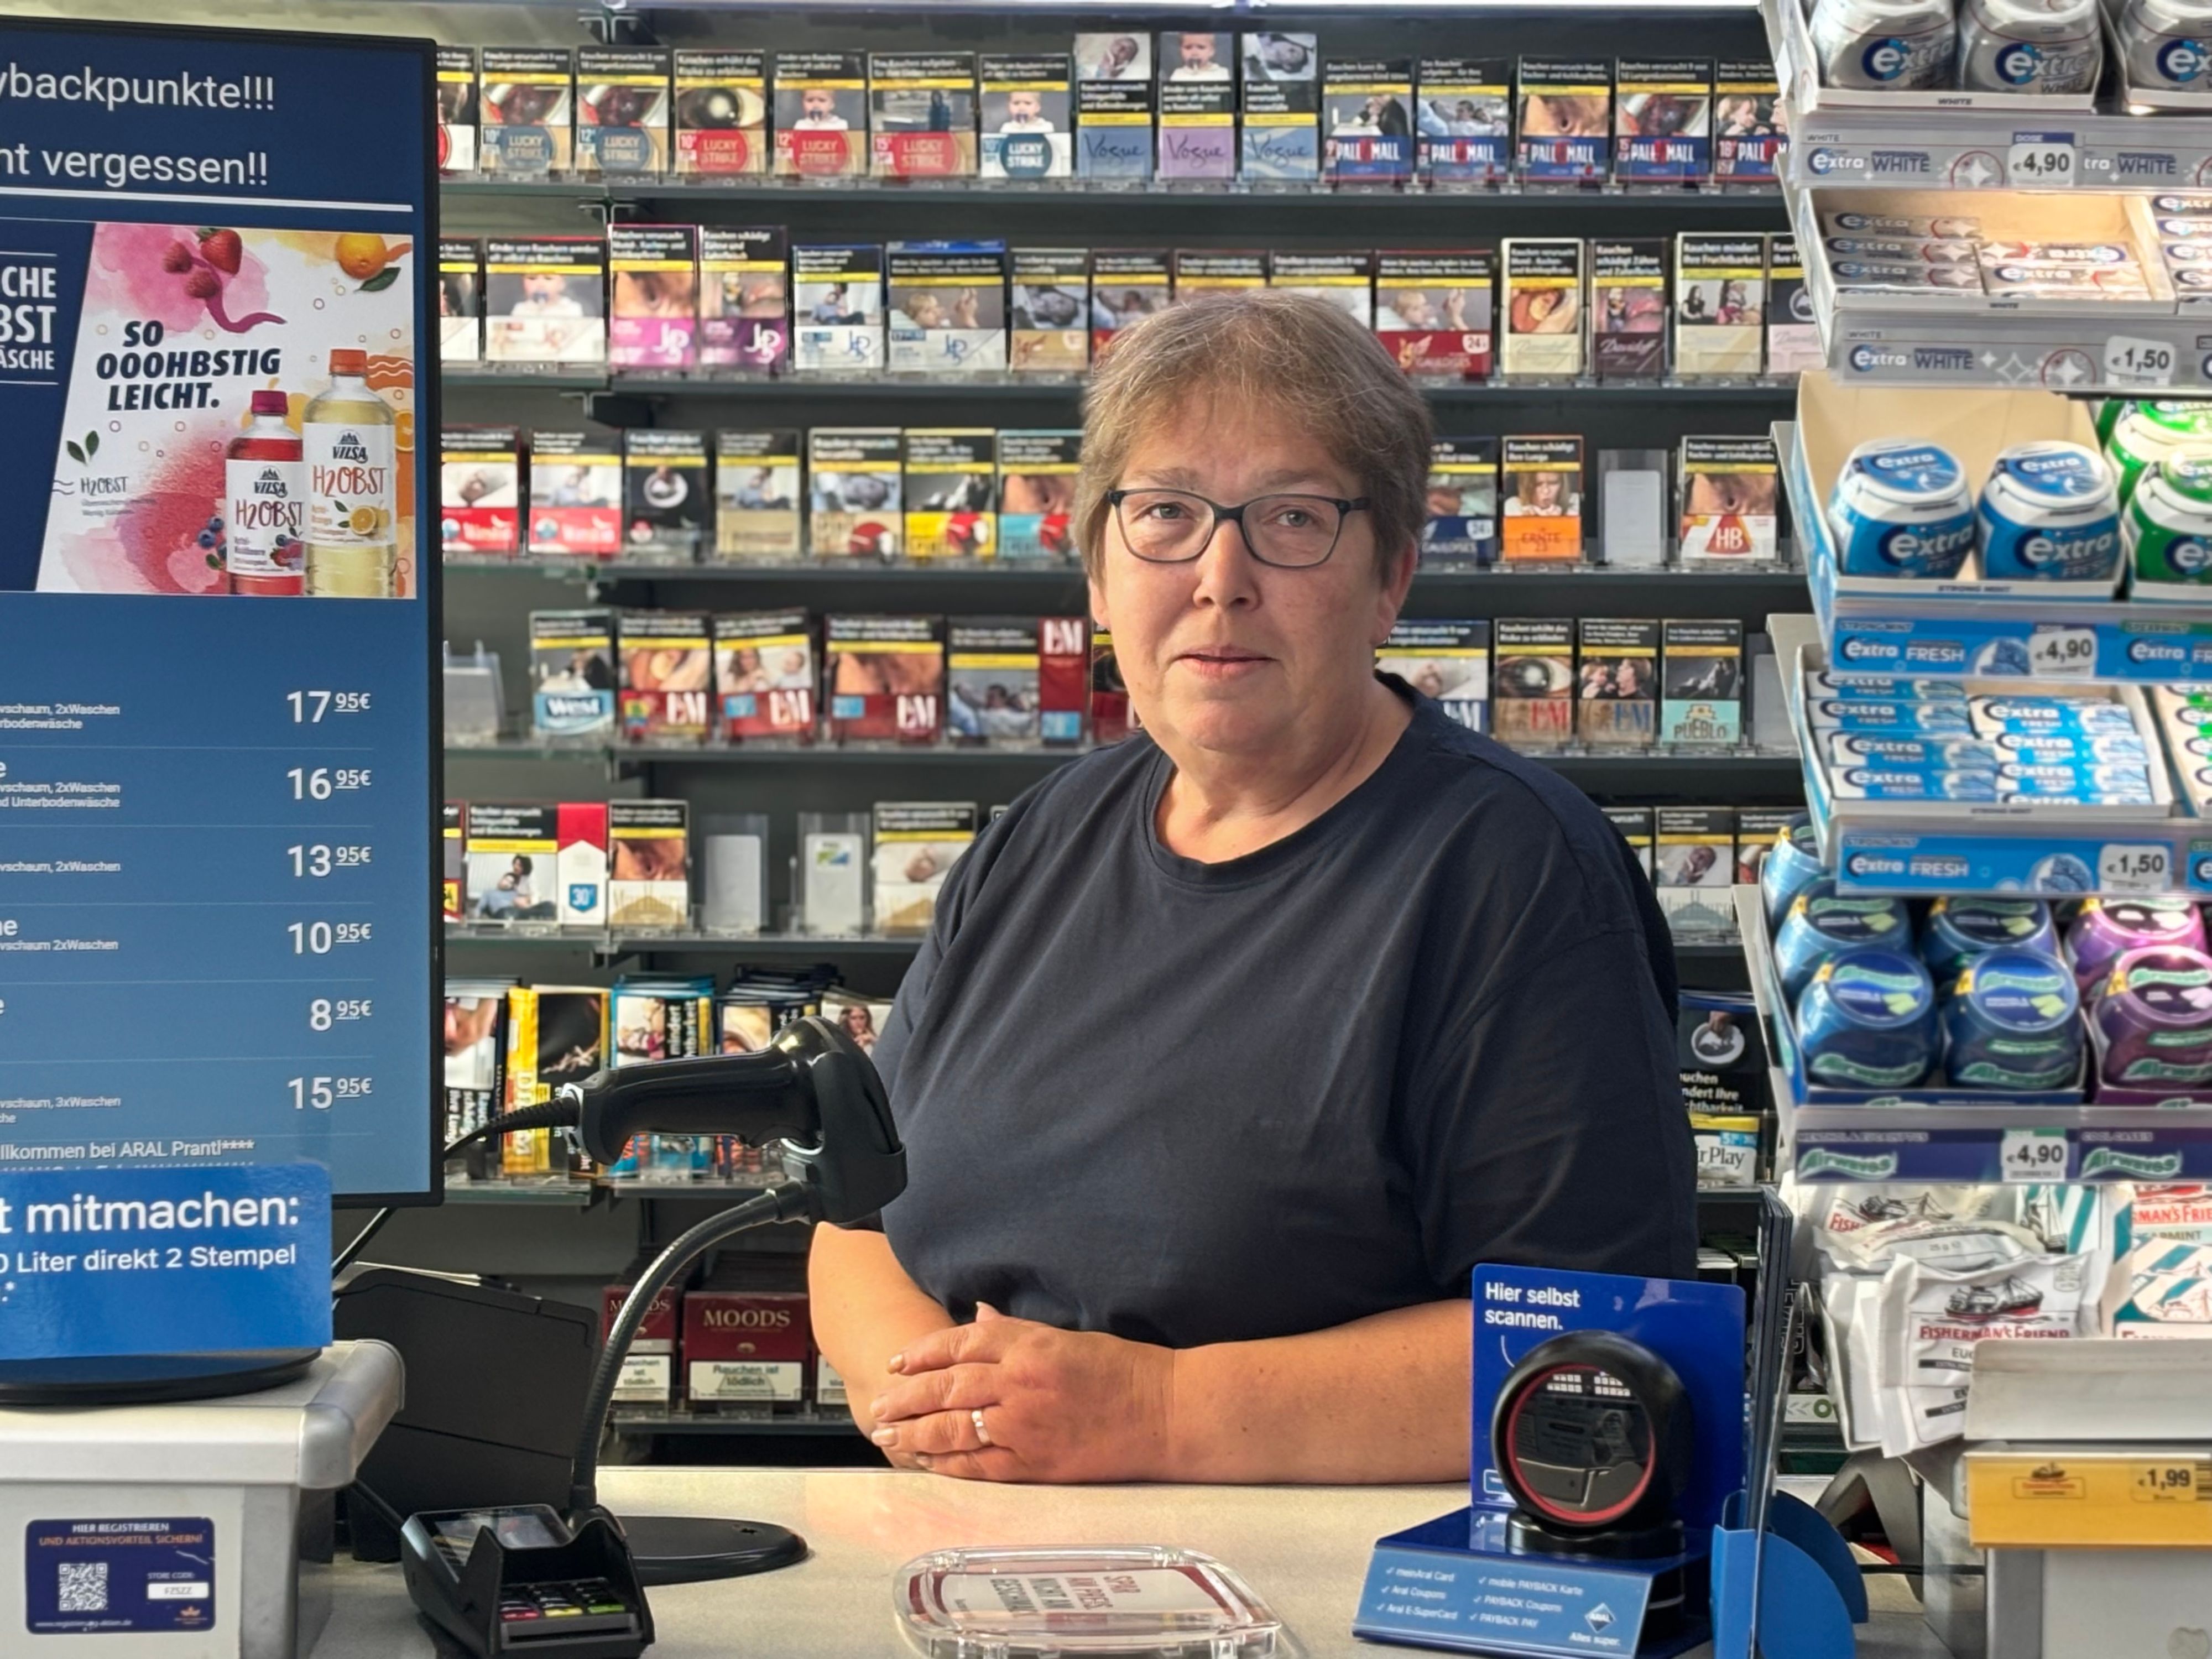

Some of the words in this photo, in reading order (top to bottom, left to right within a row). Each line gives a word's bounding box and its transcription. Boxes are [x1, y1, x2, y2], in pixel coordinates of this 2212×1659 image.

[508, 136, 543, 147] LUCKY
[604, 136, 639, 147] LUCKY
[703, 139, 738, 151] LUCKY
[802, 140, 838, 152] LUCKY
[903, 139, 944, 152] LUCKY
[1008, 142, 1043, 153] LUCKY
[1084, 133, 1145, 167] Vogue
[1167, 133, 1228, 167] Vogue
[1249, 133, 1312, 166] Vogue
[507, 147, 544, 160] STRIKE
[603, 148, 640, 161] STRIKE
[1007, 154, 1045, 168] STRIKE
[1336, 143, 1360, 161] PALL
[1371, 143, 1401, 161] MALL
[1431, 145, 1457, 162] PALL
[1467, 144, 1495, 161] MALL
[1531, 145, 1556, 162] PALL
[1566, 145, 1594, 163] MALL
[1630, 145, 1656, 162] PALL
[1666, 144, 1694, 161] MALL
[41, 150, 268, 187] vergessen!!
[1812, 152, 1864, 169] extra
[1873, 156, 1931, 173] WHITE
[123, 320, 164, 347] SO
[96, 348, 281, 379] OOOHBSTIG
[1854, 351, 1908, 369] extra
[1915, 354, 1974, 370] WHITE
[108, 382, 220, 411] LEICHT.
[332, 445, 367, 463] VILSA
[1716, 528, 1743, 549] HB
[1845, 640, 1899, 659] extra
[1906, 648, 1965, 662] FRESH
[2132, 641, 2185, 659] extra
[286, 691, 331, 723] 17
[335, 693, 371, 710] 95€
[547, 697, 600, 717] West
[1674, 720, 1726, 740] PUEBLO
[287, 768, 331, 800] 16
[335, 769, 372, 786] 95€
[287, 845, 331, 877] 13
[336, 847, 372, 863] 95€
[1853, 855, 1904, 875] extra
[1910, 860, 1969, 878] FRESH
[288, 922, 331, 954] 10
[336, 924, 372, 940] 95€
[310, 999, 331, 1031] 8
[336, 1000, 372, 1017] 95€
[288, 1077, 332, 1110] 15
[336, 1078, 372, 1095] 95€
[1715, 1088, 1739, 1100] Ihre
[90, 1141, 116, 1159] bei
[120, 1141, 168, 1157] ARAL
[27, 1191, 299, 1233] mitmachen:
[17, 1251, 77, 1273] Liter
[84, 1248, 159, 1271] direkt
[165, 1248, 182, 1268] 2
[190, 1244, 296, 1270] Stempel
[1485, 1282, 1522, 1302] Hier
[1527, 1287, 1580, 1308] selbst
[703, 1309, 791, 1327] MOODS
[1485, 1309, 1564, 1330] scannen.
[72, 1524, 96, 1533] HIER
[98, 1522, 169, 1533] REGISTRIEREN
[39, 1537, 63, 1546] UND
[66, 1535, 153, 1546] AKTIONSVORTEIL
[155, 1533, 203, 1544] SICHERN!
[1434, 1571, 1455, 1582] Card
[1392, 1586, 1408, 1595] Aral
[1410, 1588, 1446, 1600] Coupons
[1488, 1578, 1517, 1589] mobile
[1517, 1579, 1558, 1593] PAYBACK
[1559, 1585, 1584, 1597] Karte
[1387, 1604, 1404, 1615] Aral
[1484, 1595, 1524, 1610] PAYBACK
[1526, 1600, 1563, 1613] Coupons
[1479, 1613, 1519, 1626] PAYBACK
[1521, 1619, 1539, 1629] PAY
[1568, 1631, 1592, 1644] Alles
[1594, 1635, 1620, 1647] super.
